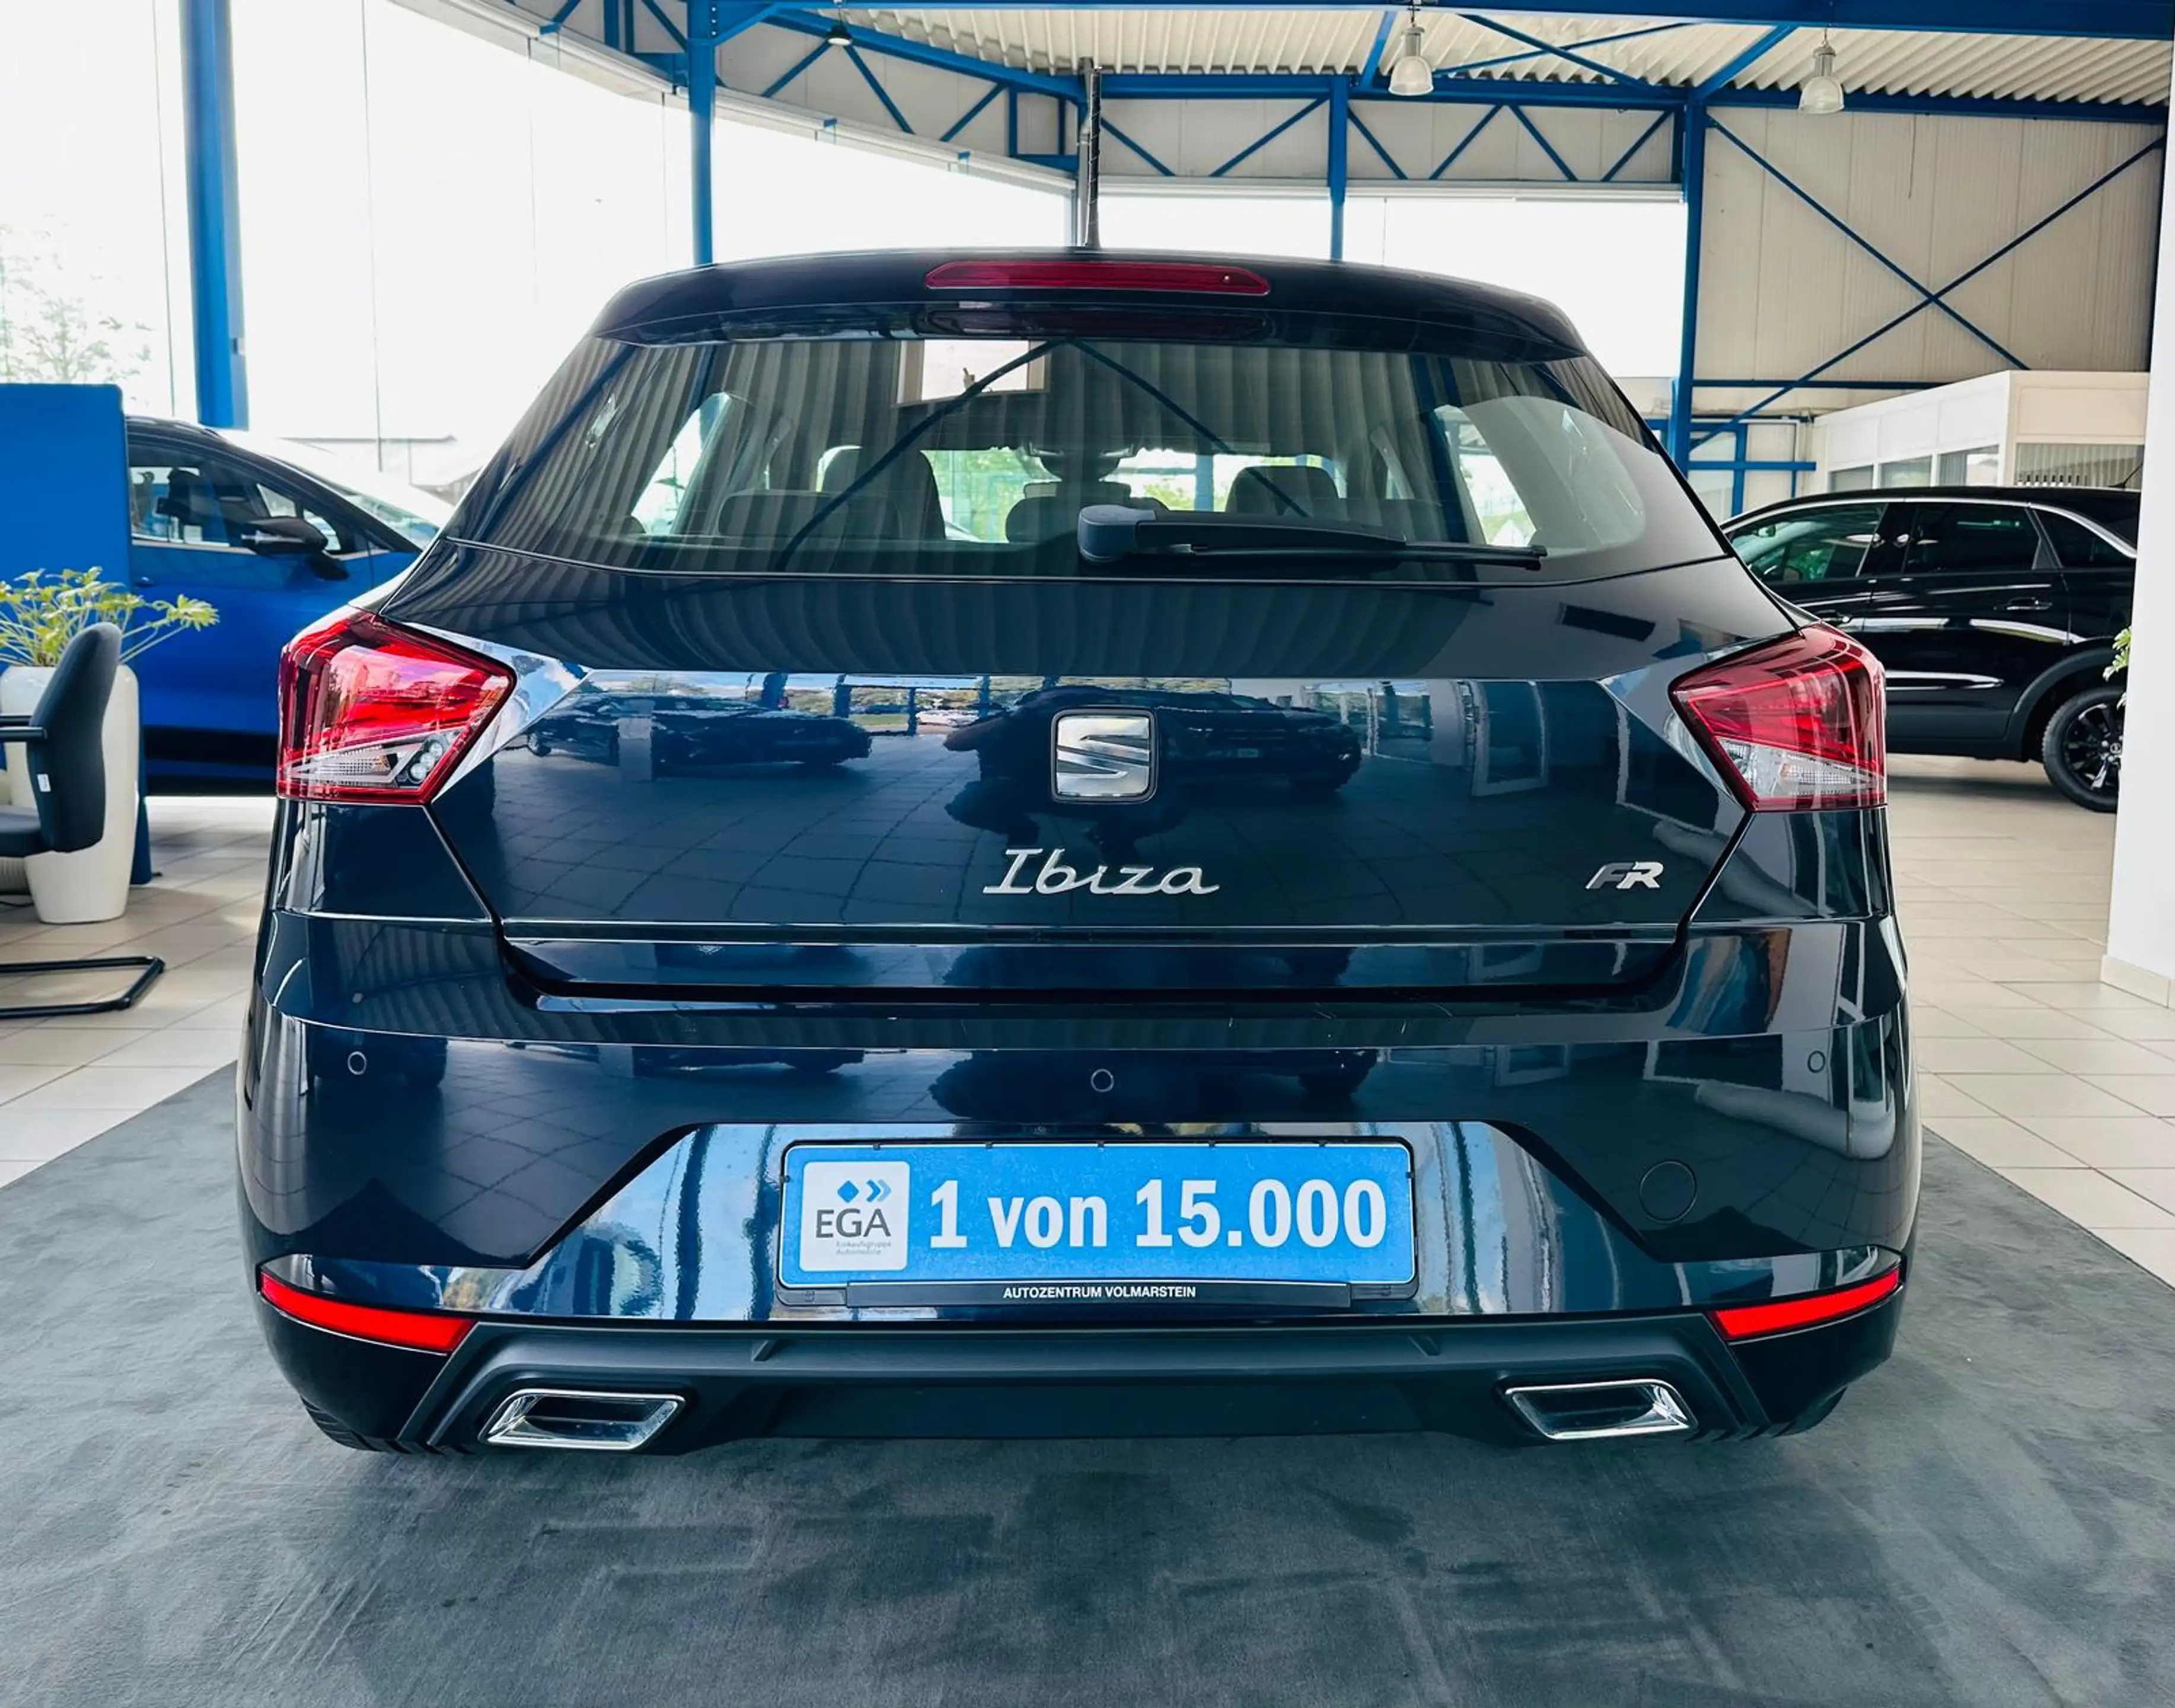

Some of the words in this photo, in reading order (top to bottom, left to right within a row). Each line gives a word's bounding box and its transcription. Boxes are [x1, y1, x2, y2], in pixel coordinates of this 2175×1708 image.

[983, 848, 1220, 895] Ibiza
[1585, 861, 1664, 890] FR
[815, 1208, 892, 1238] EGA
[930, 1180, 968, 1248] 1
[988, 1196, 1108, 1248] von
[1136, 1179, 1387, 1248] 15.000
[1003, 1286, 1102, 1298] AUTOZENTRUM
[1106, 1286, 1197, 1298] VOLMARSTEIN
